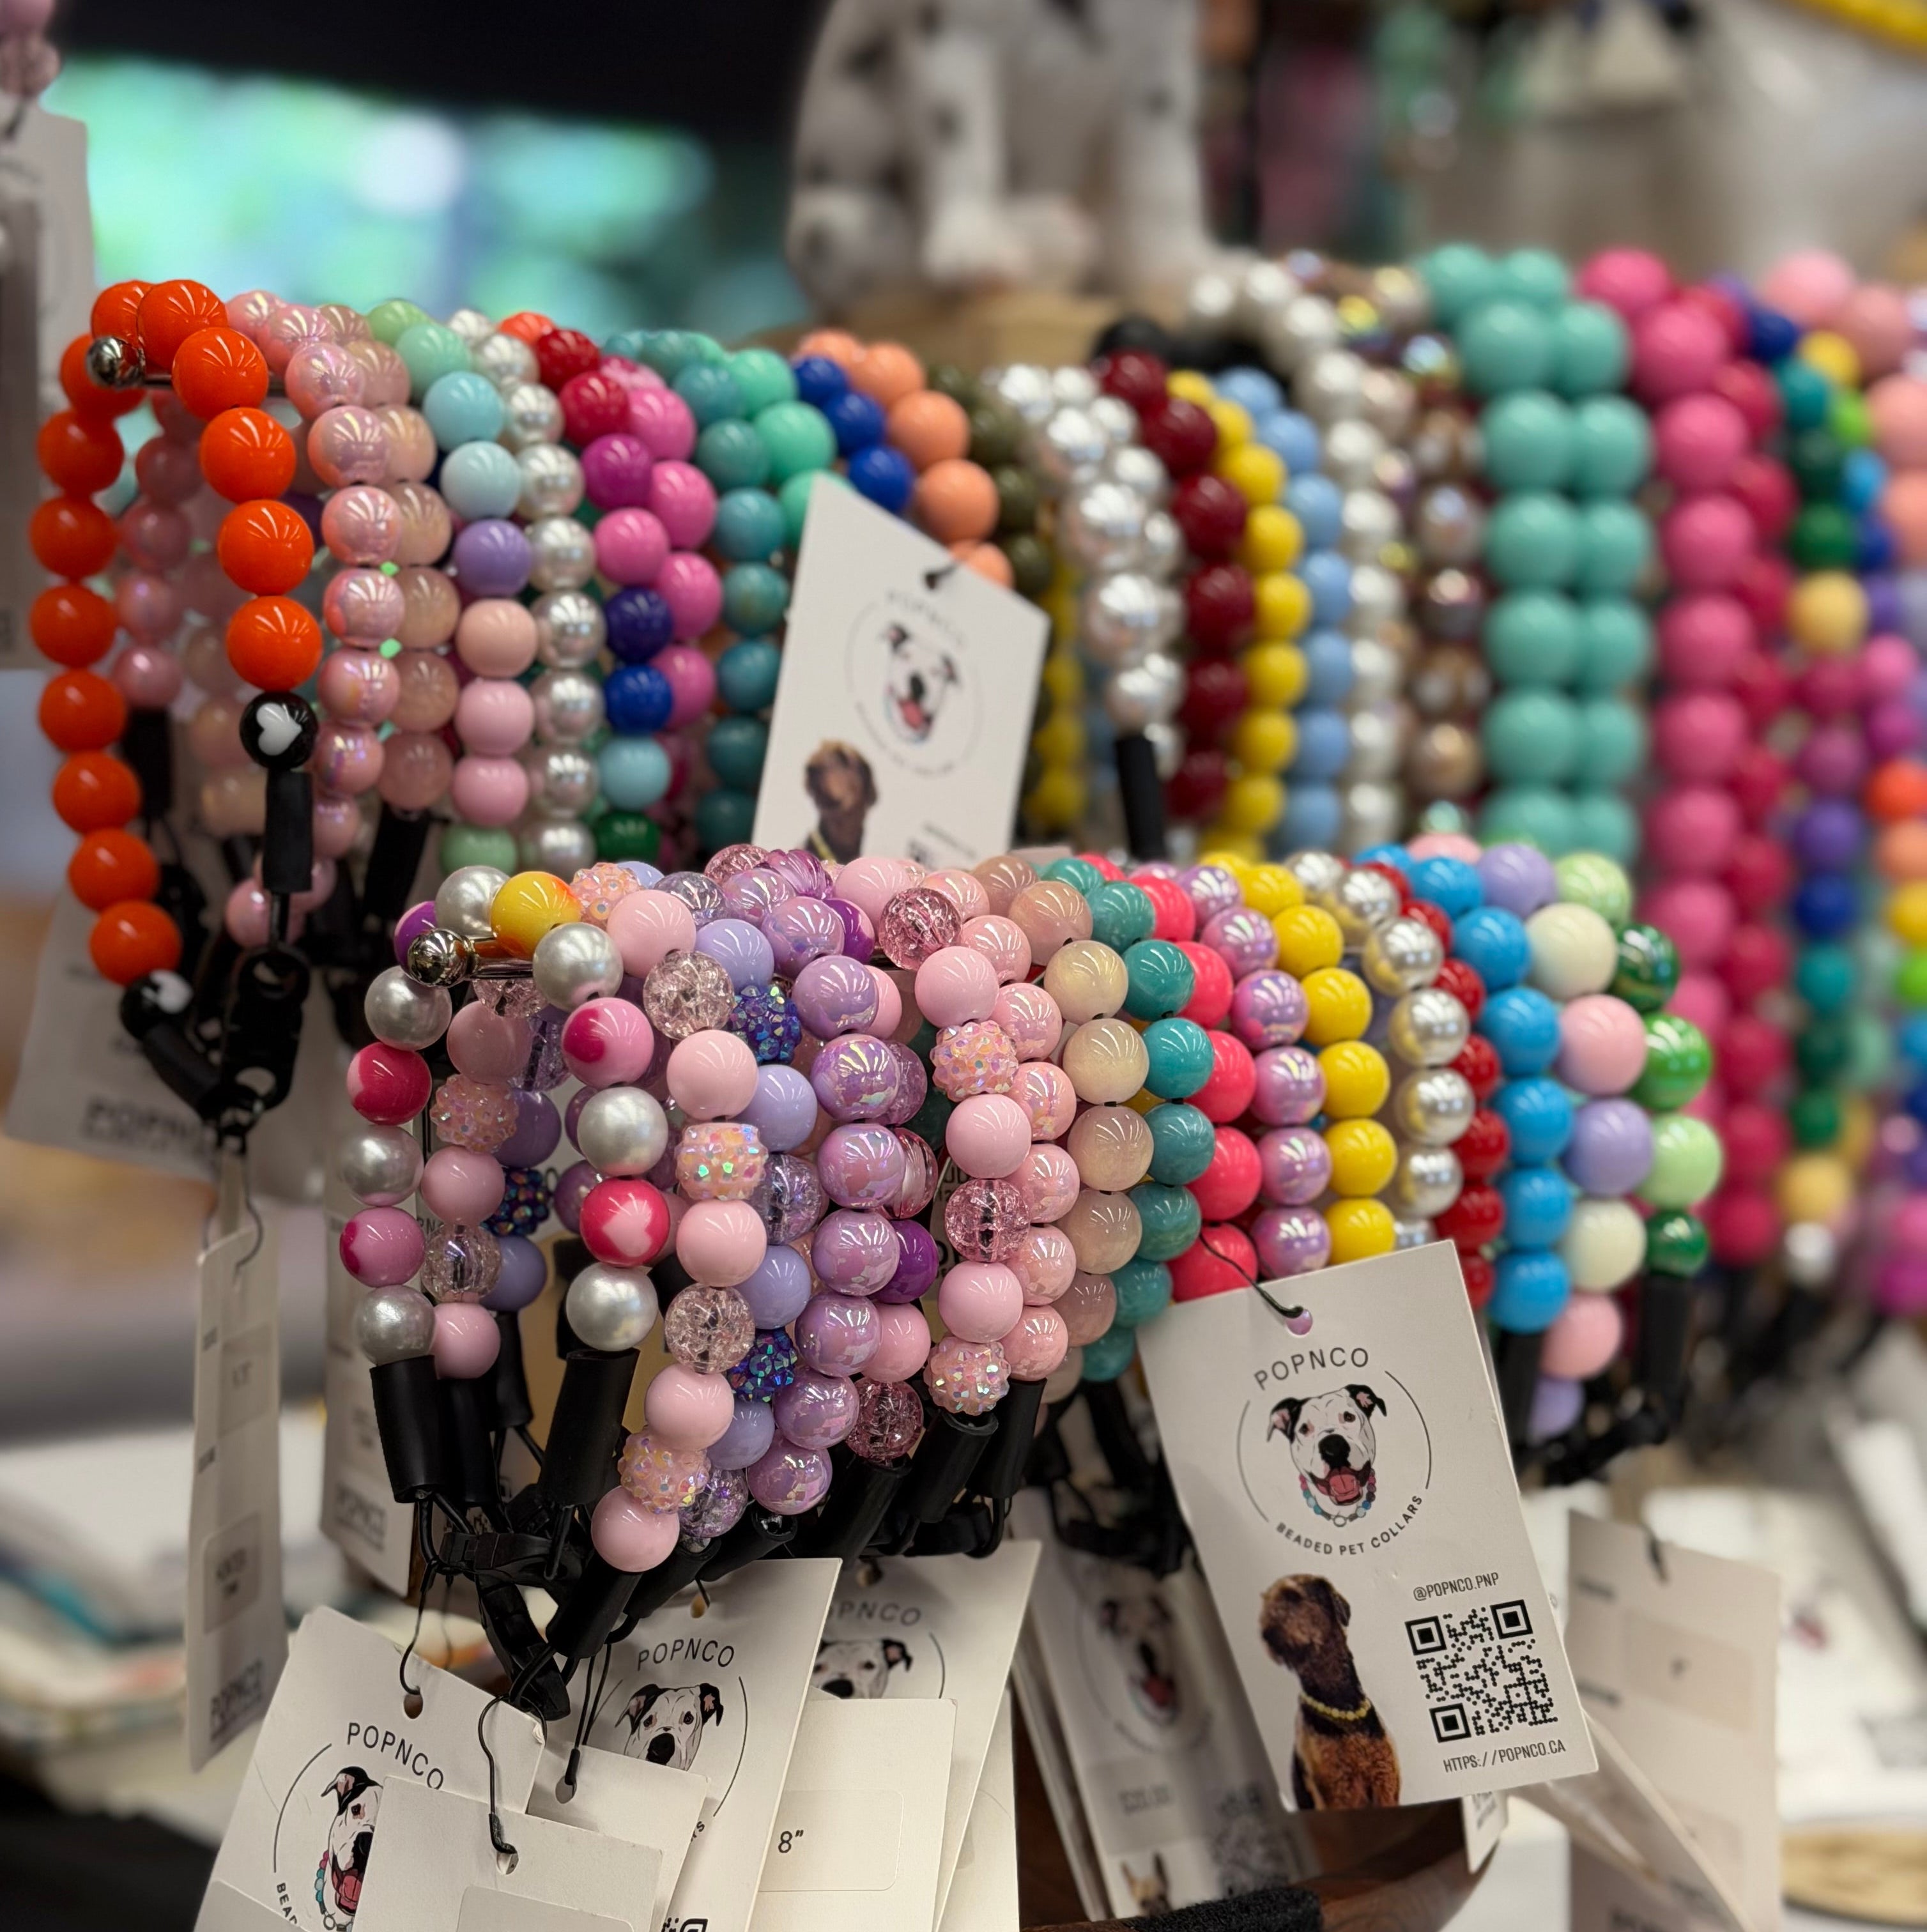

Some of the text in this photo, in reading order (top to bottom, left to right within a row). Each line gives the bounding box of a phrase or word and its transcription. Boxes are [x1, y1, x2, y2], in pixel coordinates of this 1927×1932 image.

[1254, 1347, 1369, 1391] POPNCO
[1276, 1494, 1422, 1556] BEADED PET COLLARS
[1413, 1572, 1500, 1602] @POPNCO.PNP
[638, 1637, 735, 1672] POPNCO
[347, 1722, 444, 1790] POPNCO
[1443, 1738, 1567, 1773] HTTPS://POPNCO.CA
